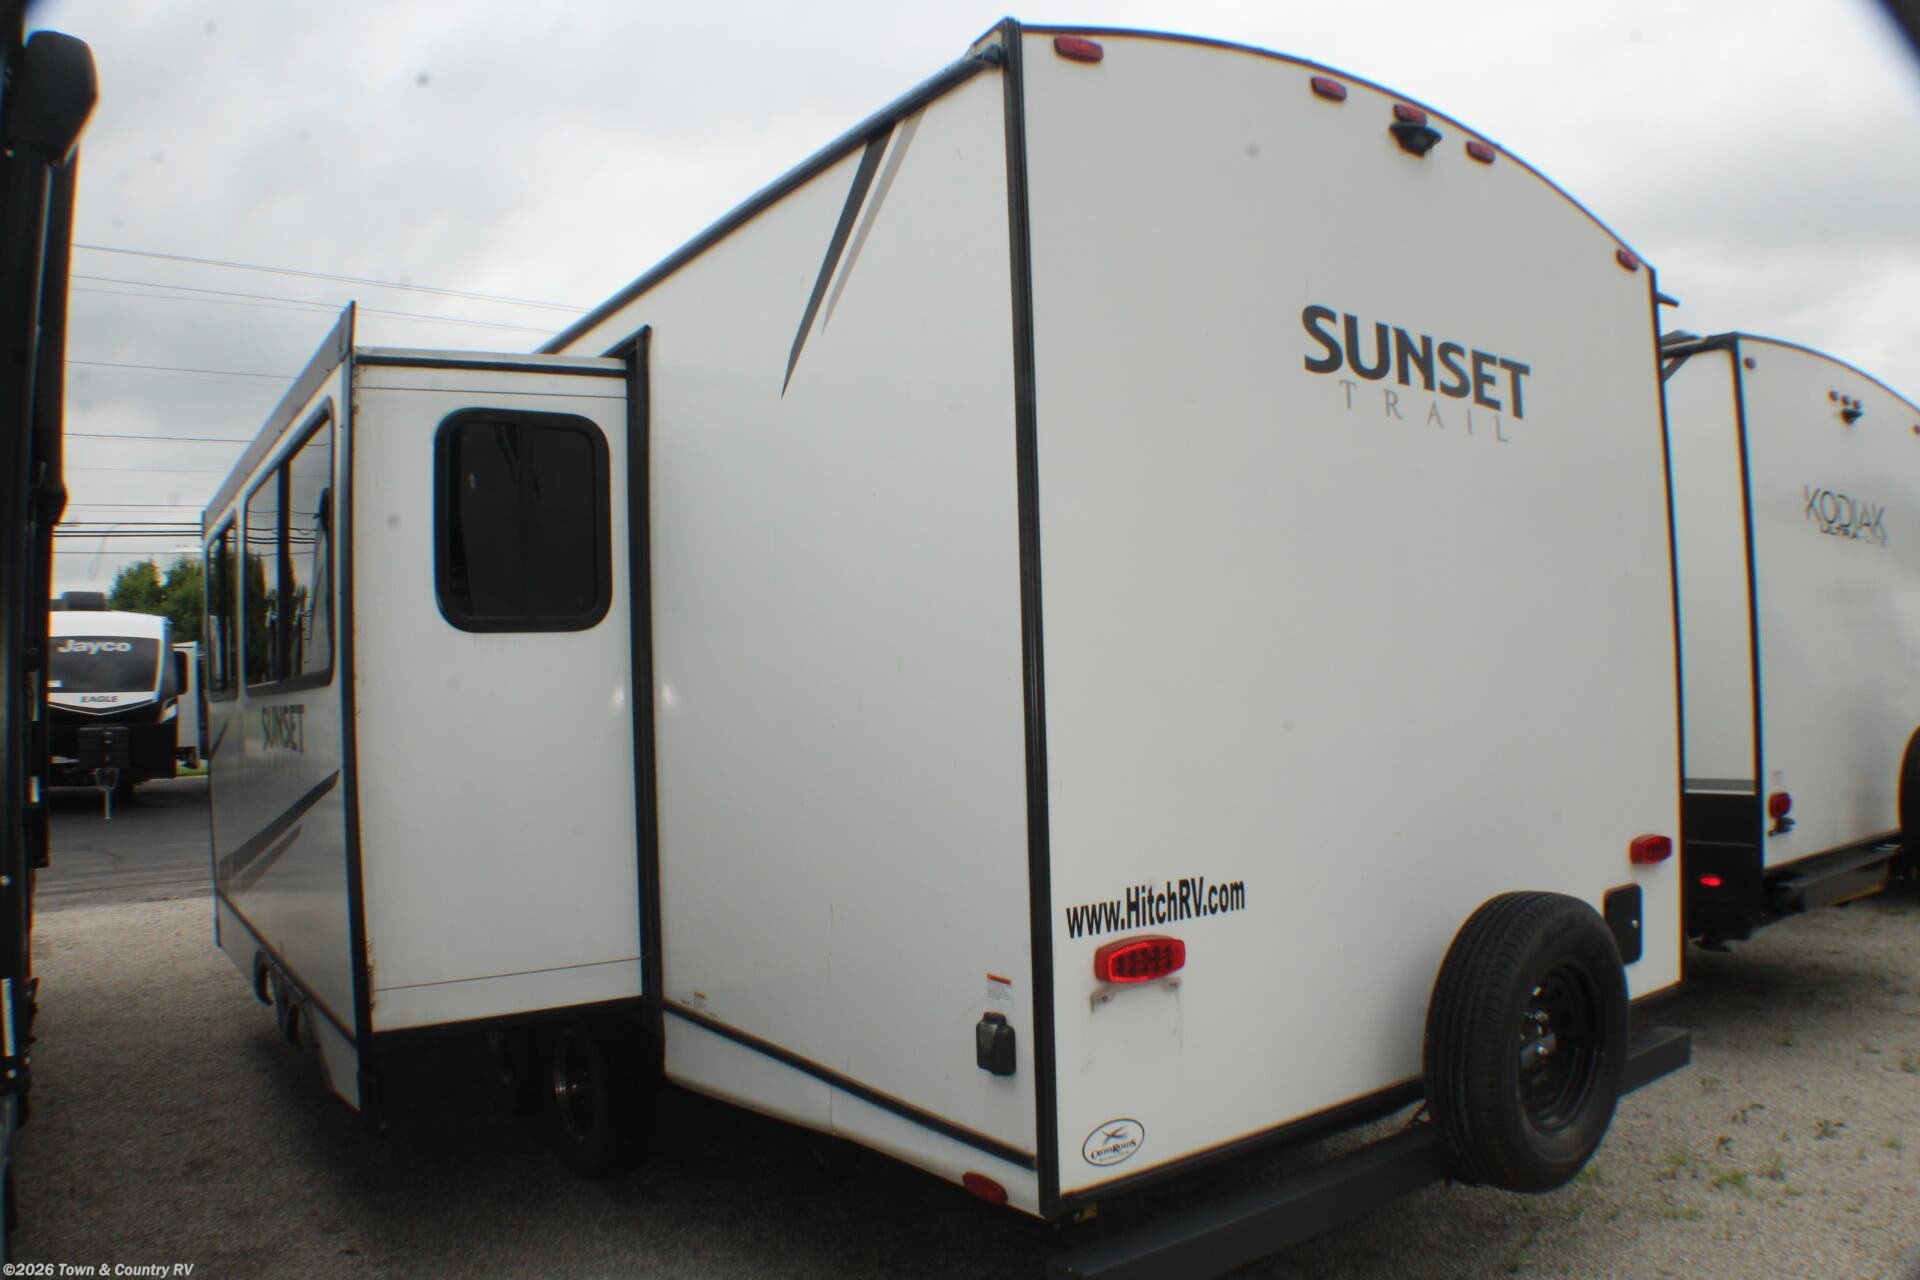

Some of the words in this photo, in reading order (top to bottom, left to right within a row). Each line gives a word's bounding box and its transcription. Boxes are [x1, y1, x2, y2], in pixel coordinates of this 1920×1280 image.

[1302, 304, 1530, 420] SUNSET
[1339, 379, 1509, 443] TRAIL
[1804, 485, 1887, 544] KODIAK
[57, 639, 132, 655] Jayco
[80, 695, 120, 703] EAGLE
[261, 704, 305, 754] SUNSET
[1066, 876, 1245, 939] www.HitchRV.com
